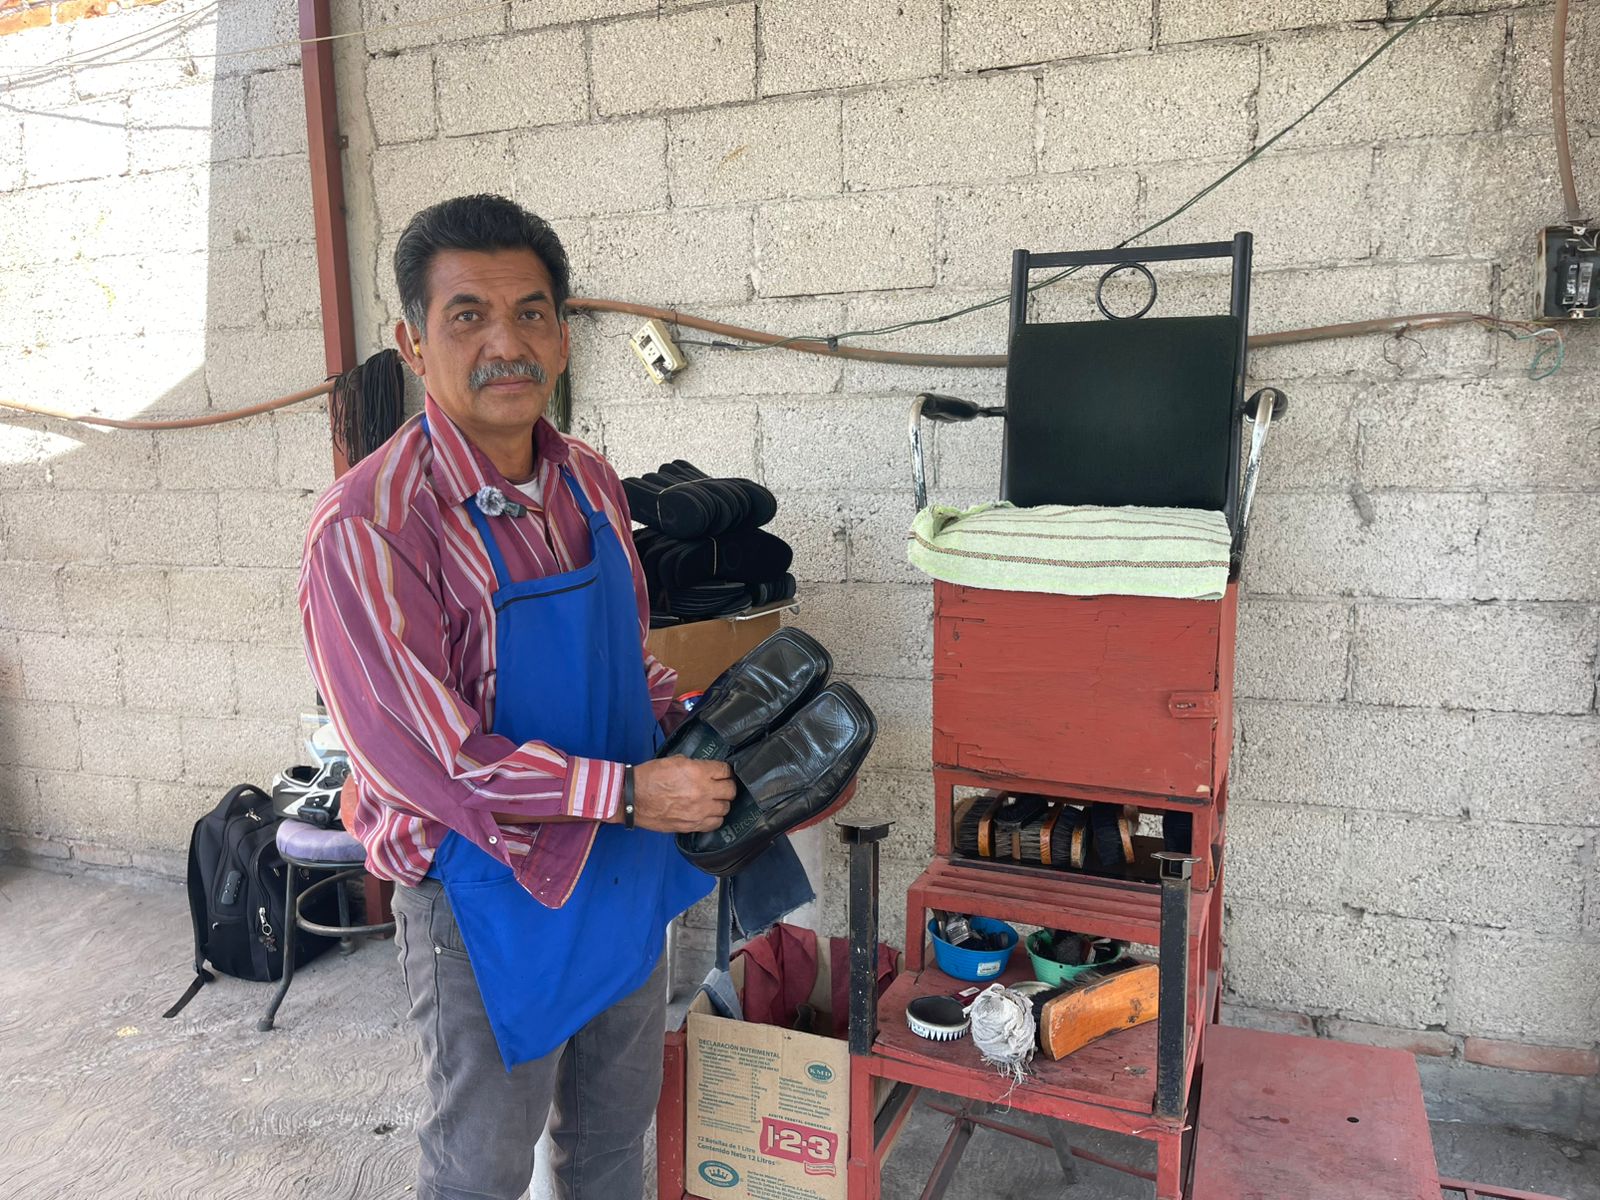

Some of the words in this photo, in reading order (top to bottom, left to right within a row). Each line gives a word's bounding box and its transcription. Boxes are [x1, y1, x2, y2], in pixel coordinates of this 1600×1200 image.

[739, 1046, 780, 1059] NUTRIMENTAL
[697, 1142, 730, 1155] Contenido
[731, 1150, 747, 1159] Neto
[756, 1156, 776, 1166] Litros
[742, 1145, 756, 1153] Litro
